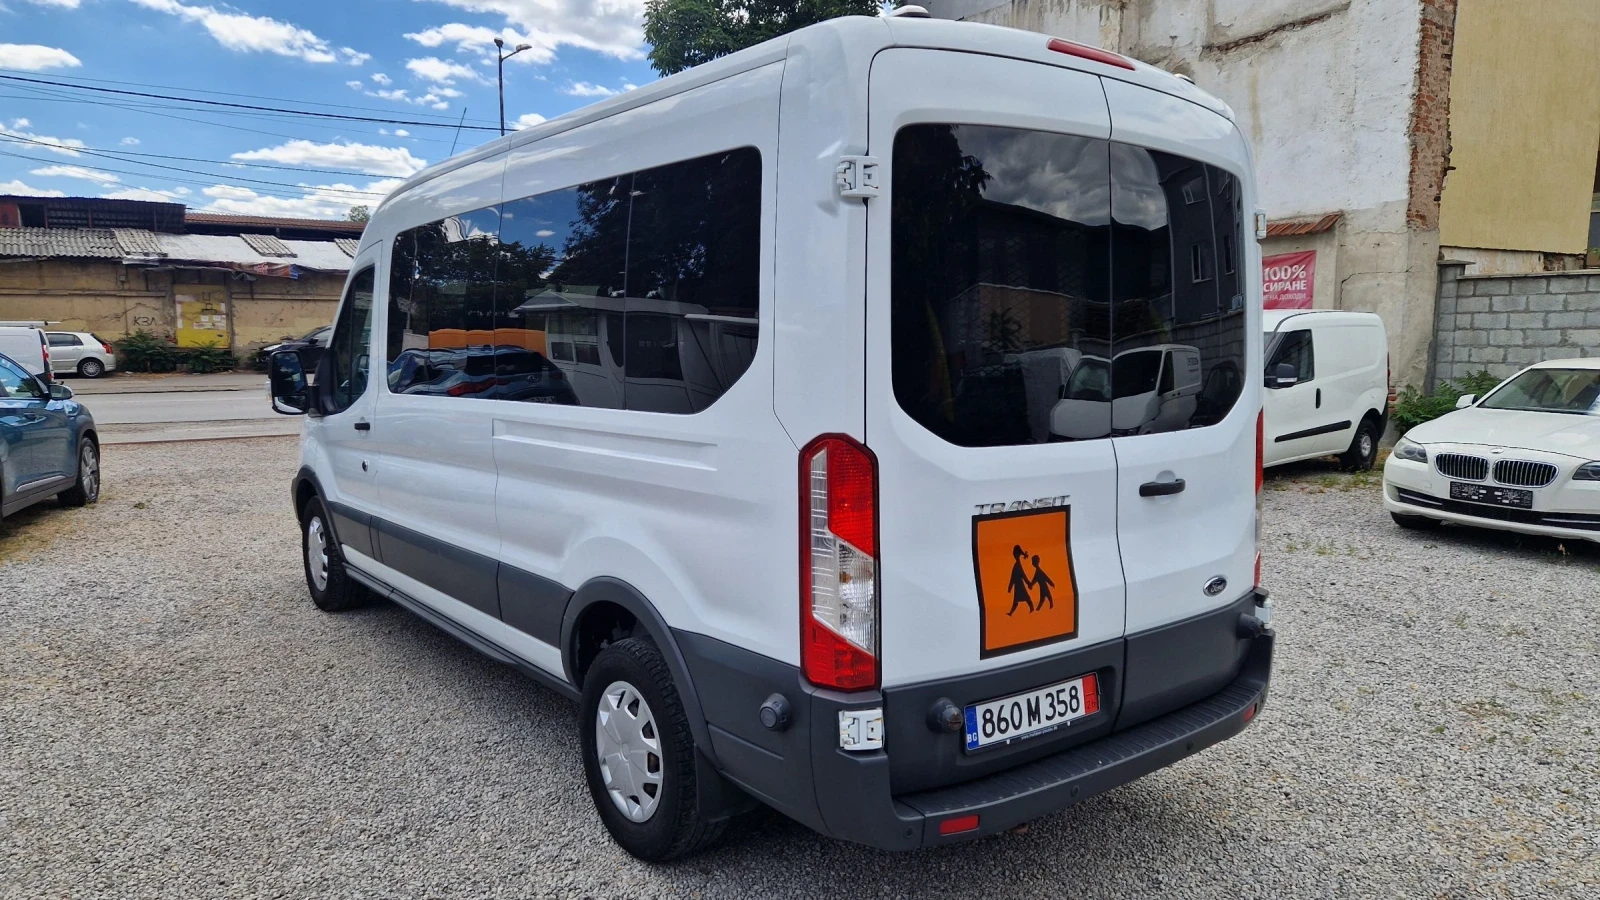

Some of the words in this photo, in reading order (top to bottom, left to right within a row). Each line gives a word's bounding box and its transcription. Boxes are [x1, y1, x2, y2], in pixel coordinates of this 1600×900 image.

[1264, 265, 1306, 281] 100%
[974, 495, 1071, 515] TRANSIT
[982, 701, 1023, 738] 860
[1027, 695, 1042, 727] M
[1045, 685, 1080, 721] 358
[967, 732, 978, 743] BG
